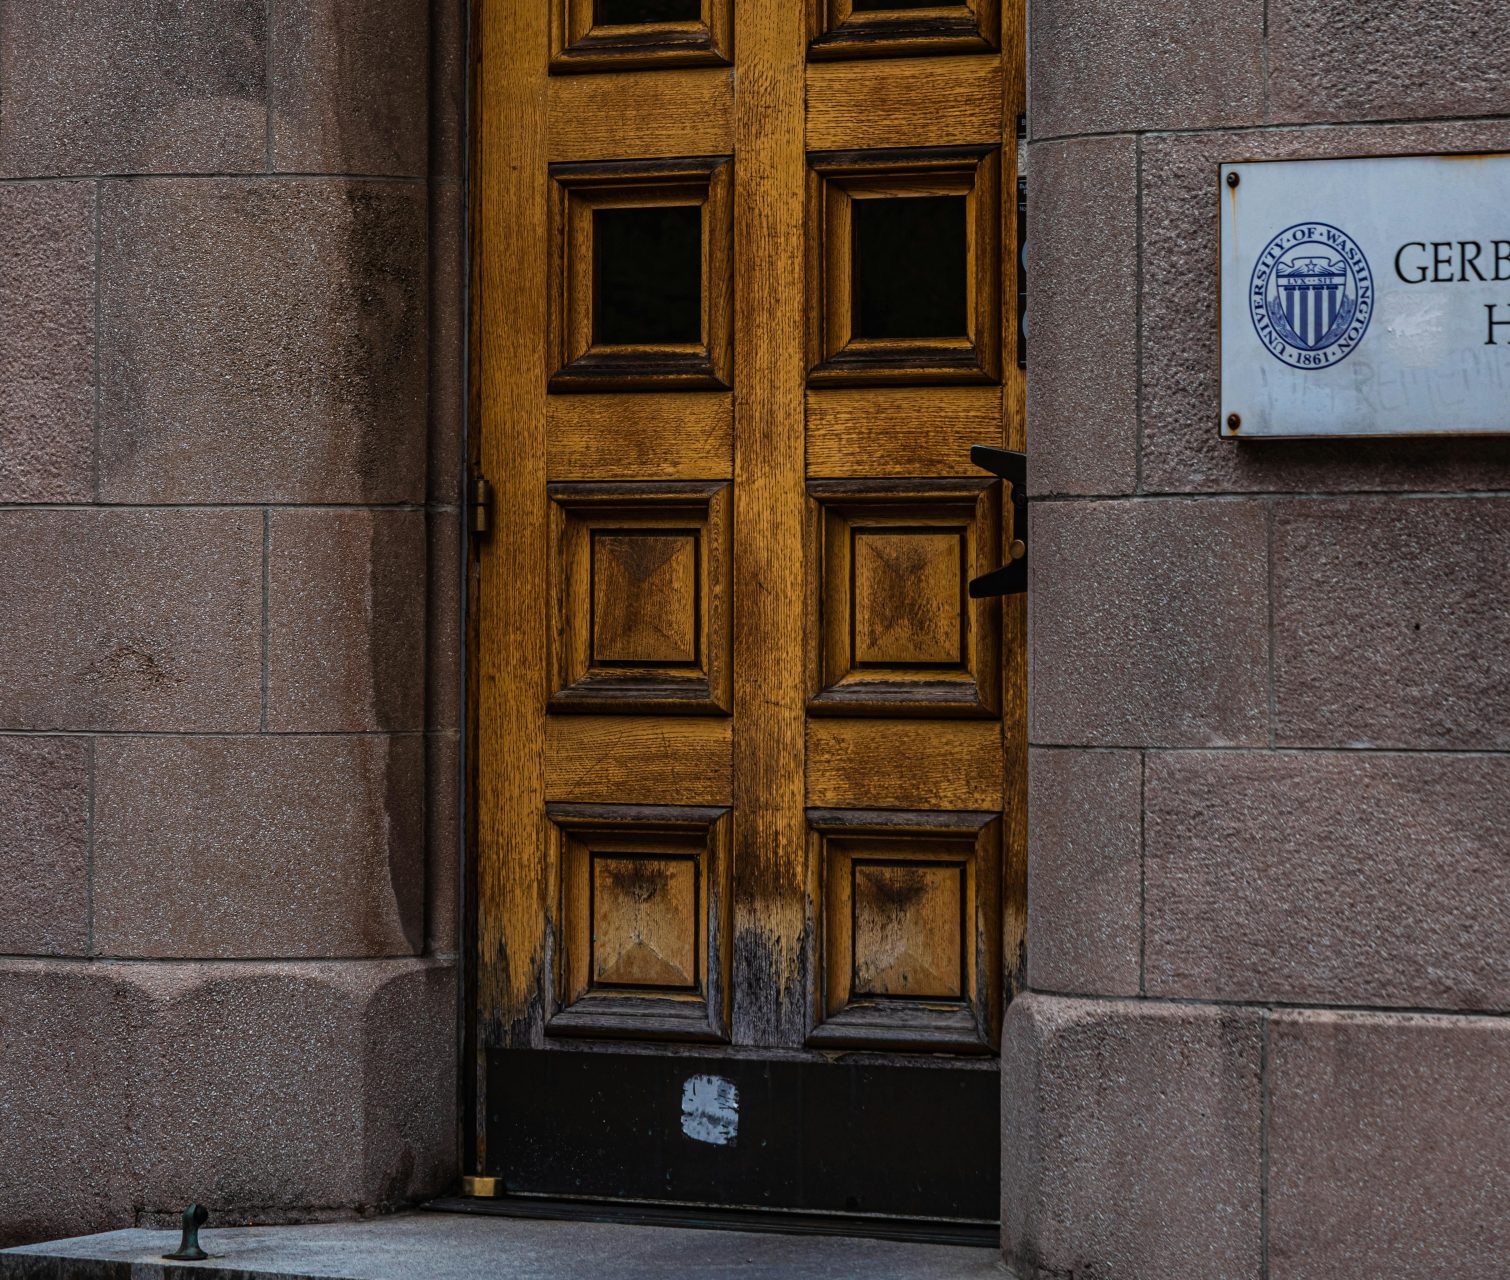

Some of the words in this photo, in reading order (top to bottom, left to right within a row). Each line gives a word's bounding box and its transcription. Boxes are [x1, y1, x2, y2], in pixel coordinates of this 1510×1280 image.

[1394, 240, 1510, 284] GERB
[1253, 238, 1287, 356] UNIVERSITY
[1292, 227, 1317, 241] OF
[1326, 229, 1370, 354] WASHINGTON
[1288, 277, 1307, 285] LVX
[1317, 277, 1335, 285] SIT
[1295, 351, 1330, 366] 1861
